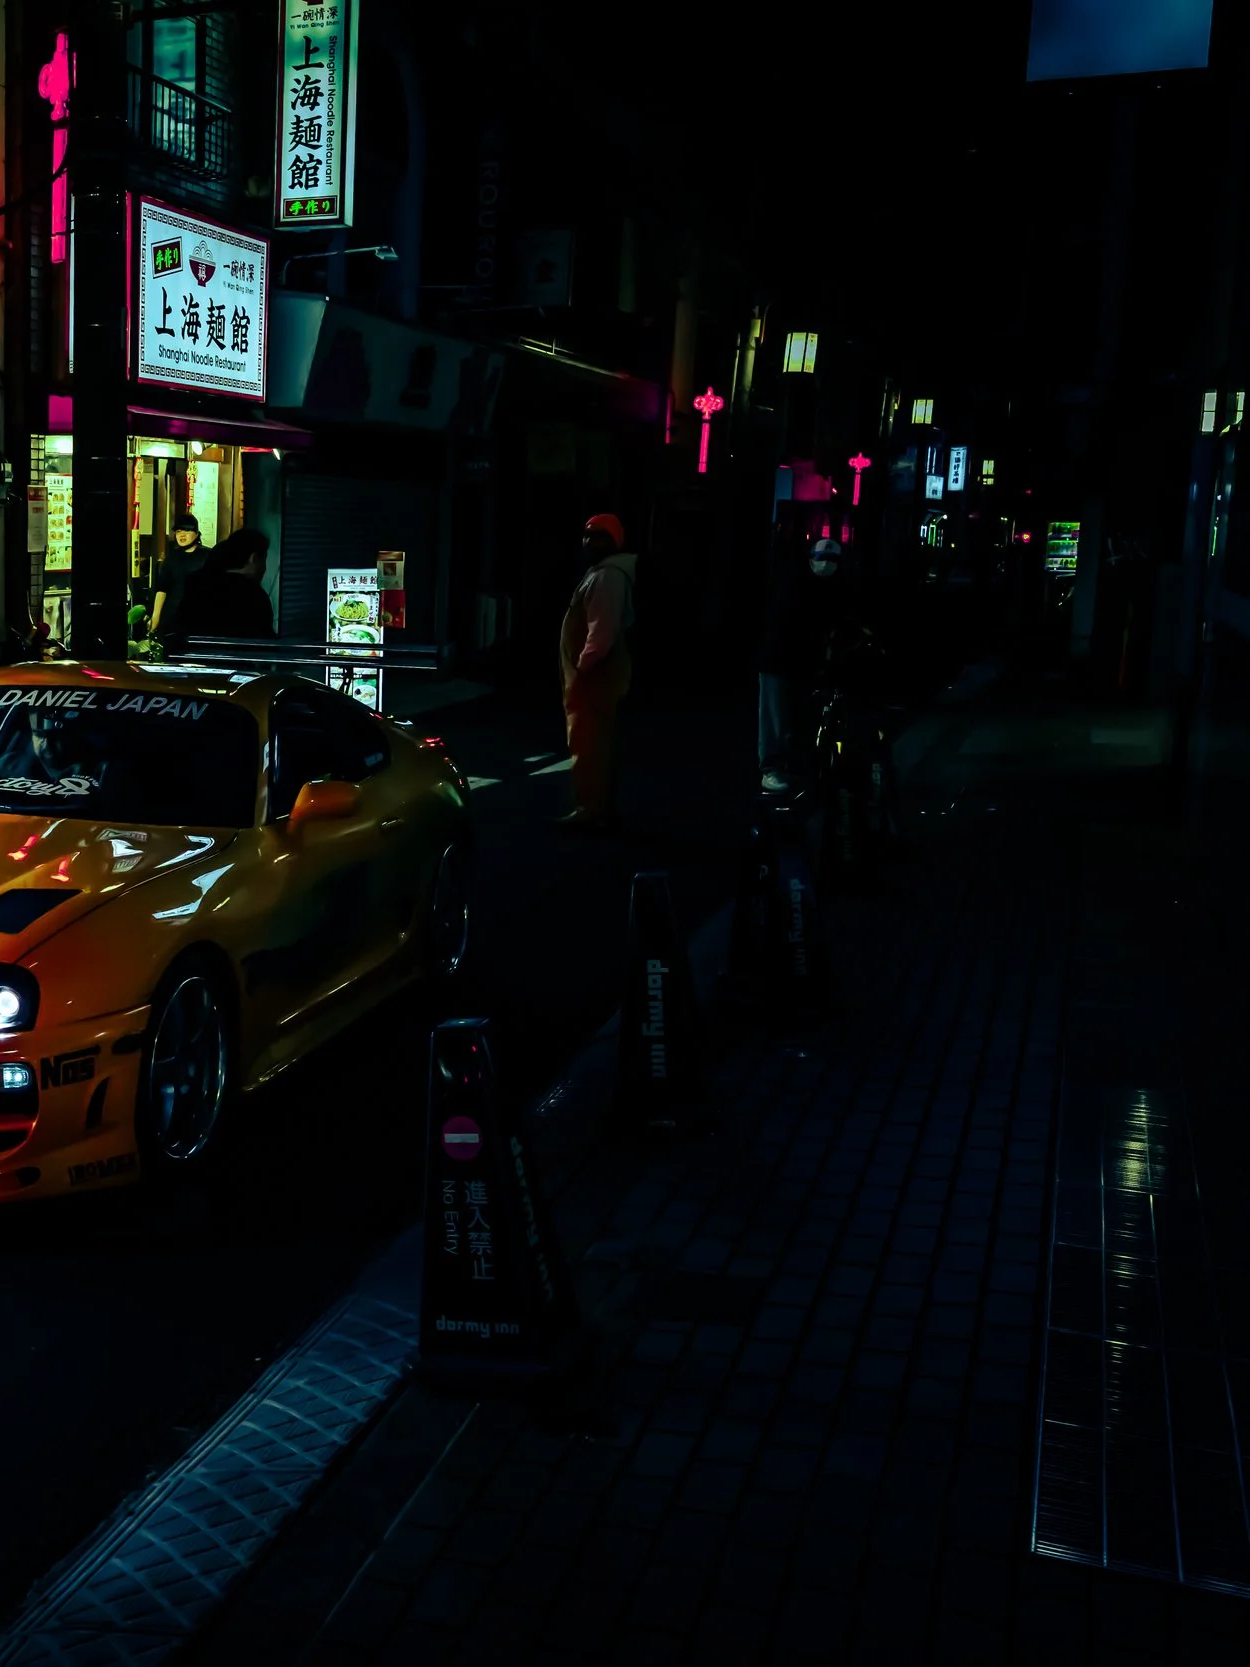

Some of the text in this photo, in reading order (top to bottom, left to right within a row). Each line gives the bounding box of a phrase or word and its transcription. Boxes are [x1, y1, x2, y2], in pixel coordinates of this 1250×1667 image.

[291, 5, 339, 21] 一碗情深
[324, 35, 338, 186] Shanghai Noodle Restaurant
[289, 199, 332, 216] 手作り
[154, 247, 180, 272] 手作り
[158, 344, 247, 373] Shanghai Noodle Restaurant
[105, 694, 210, 721] JAPAN
[641, 958, 670, 1080] dormy inn
[441, 1180, 459, 1258] No Entry
[464, 1179, 497, 1282] 進入禁止
[435, 1315, 521, 1340] dormy inn
